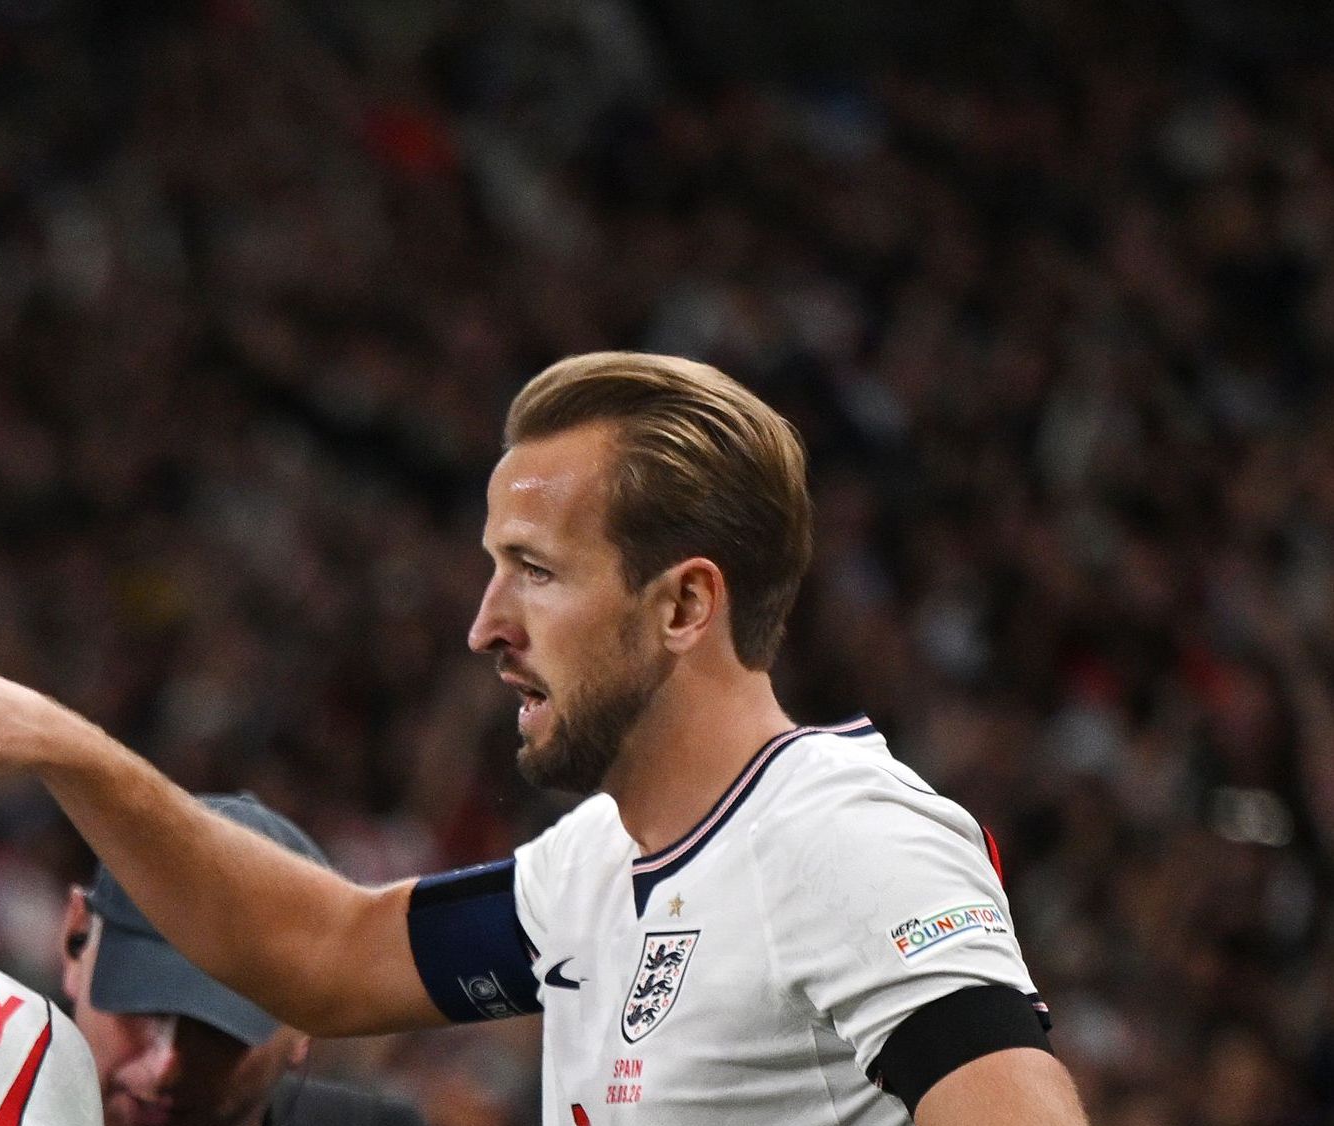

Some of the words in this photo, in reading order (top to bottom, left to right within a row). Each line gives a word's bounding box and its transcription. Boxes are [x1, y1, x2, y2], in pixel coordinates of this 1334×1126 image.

[891, 918, 921, 939] UEFA
[895, 908, 1004, 954] FOUNDATION
[613, 1058, 644, 1079] SPAIN
